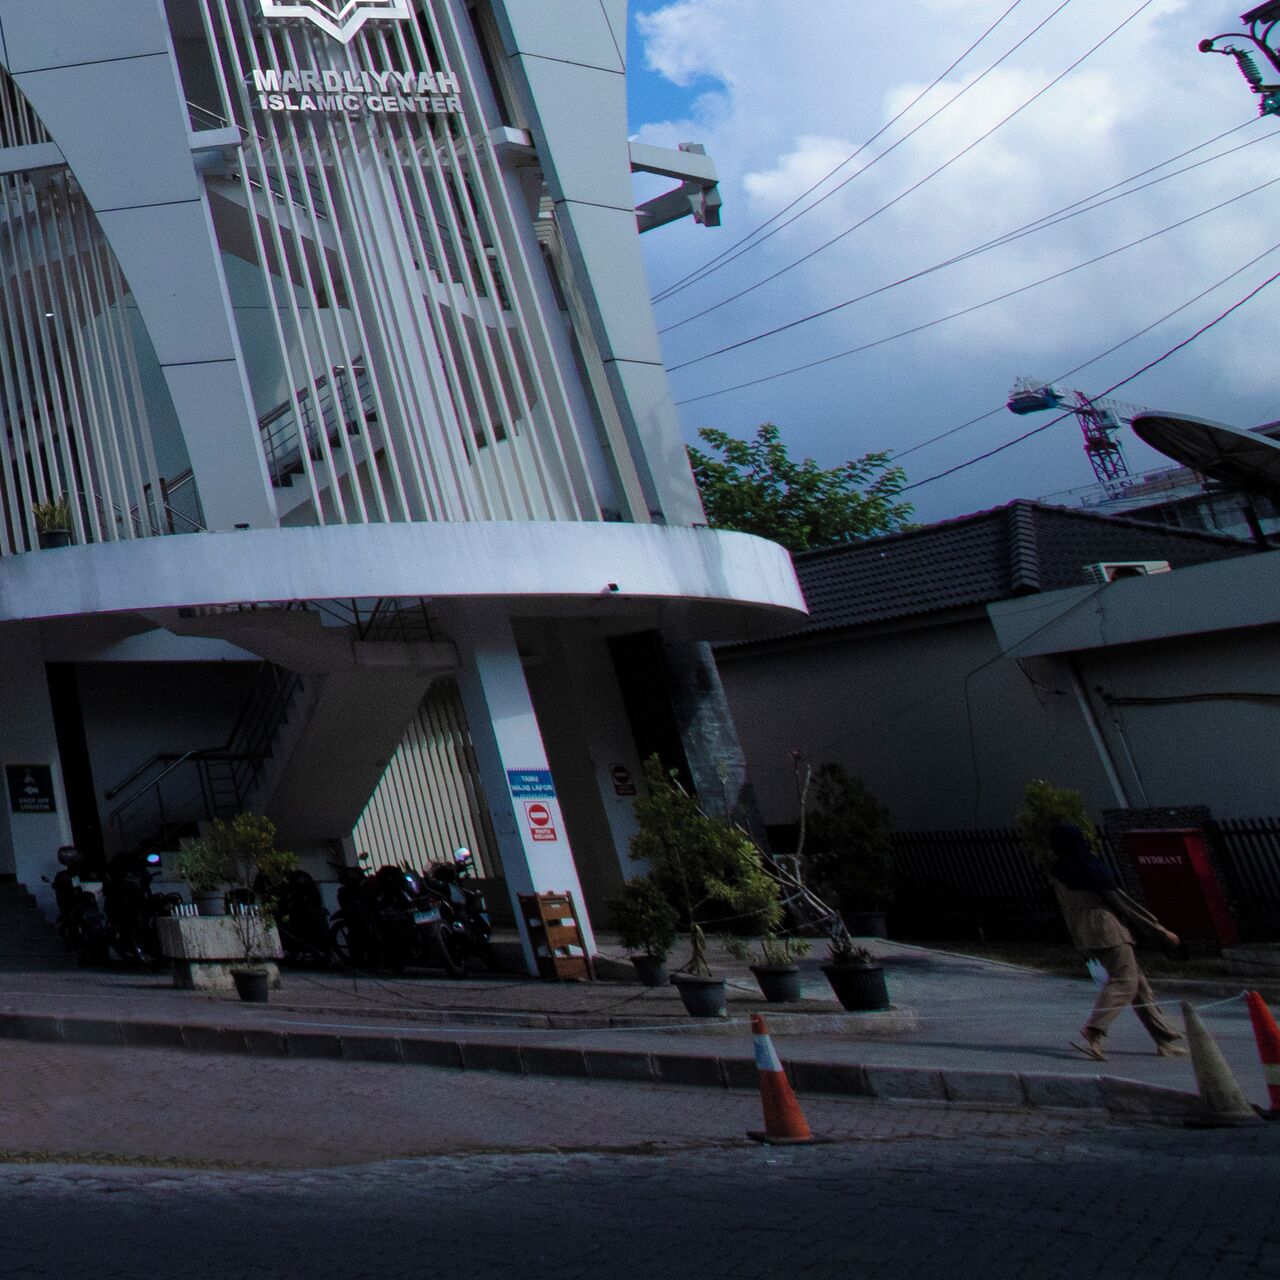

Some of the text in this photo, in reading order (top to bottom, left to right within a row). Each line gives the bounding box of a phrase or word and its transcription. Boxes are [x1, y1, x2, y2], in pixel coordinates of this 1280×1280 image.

[252, 69, 461, 94] MARDLIYYAH
[259, 94, 465, 113] ISLAMIC CENTER
[1138, 855, 1183, 864] HYDRANT
